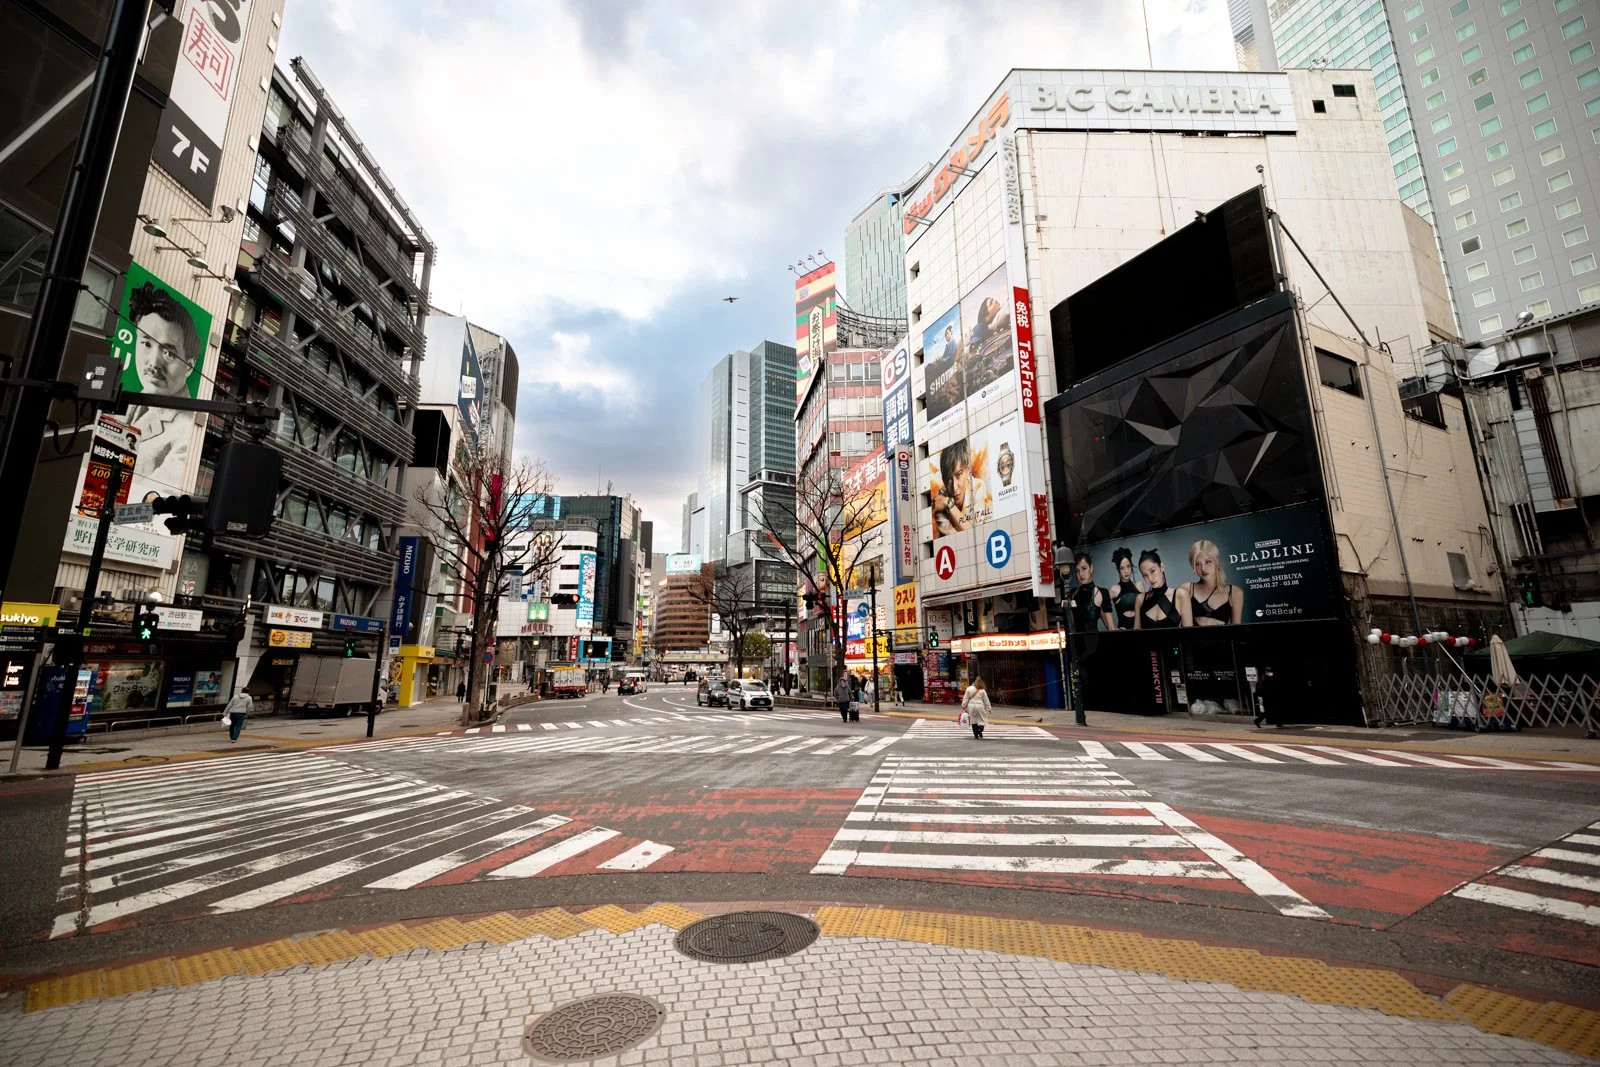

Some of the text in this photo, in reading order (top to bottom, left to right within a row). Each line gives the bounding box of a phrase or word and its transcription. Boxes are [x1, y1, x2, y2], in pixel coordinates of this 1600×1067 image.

[188, 19, 229, 91] 寿司
[1030, 85, 1282, 115] BIC CAMERA
[171, 125, 209, 174] 7F
[903, 92, 1012, 235] ビックカメラ
[1015, 300, 1030, 328] 免税
[884, 348, 908, 391] OS
[998, 485, 1018, 497] HUAWEI
[403, 544, 413, 574] MIZUHO
[939, 549, 953, 575] A
[990, 535, 1008, 564] B
[1229, 543, 1315, 564] DEADLINE
[1245, 572, 1303, 585] ZeroBase SHIBUYA
[1250, 582, 1278, 590] 2026.02.27
[895, 588, 915, 606] クスリ
[896, 606, 916, 626] 調剤
[989, 639, 1027, 647] ビックカメラ
